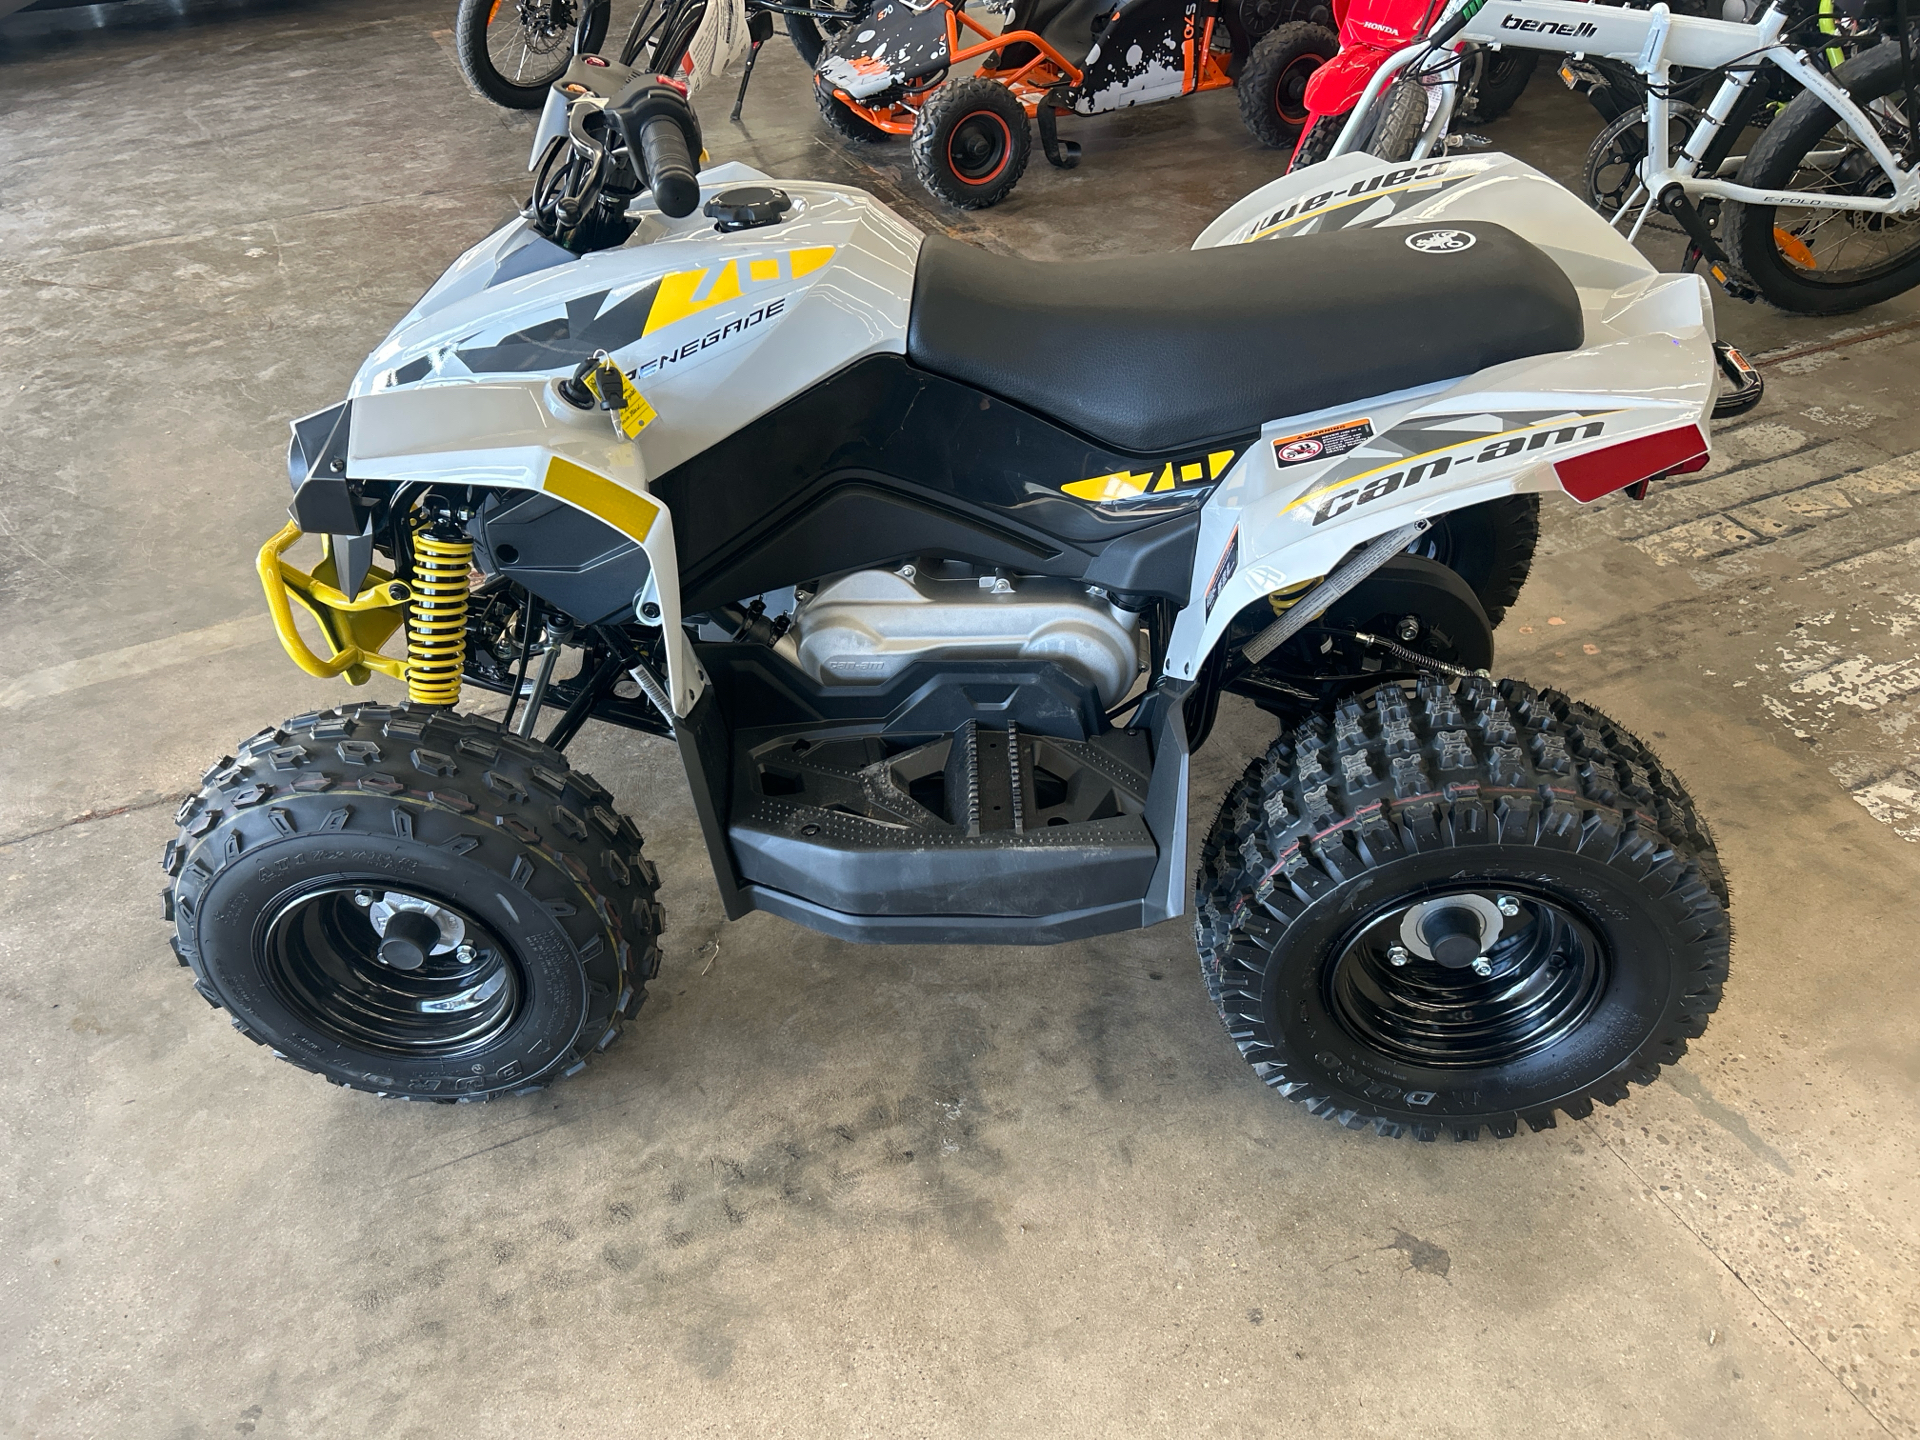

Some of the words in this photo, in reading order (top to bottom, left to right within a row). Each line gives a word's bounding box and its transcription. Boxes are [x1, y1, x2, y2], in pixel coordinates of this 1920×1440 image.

[877, 4, 894, 21] S70
[1363, 21, 1399, 36] HONDA
[1500, 13, 1598, 38] benelli
[1763, 196, 1821, 206] E-FOLD
[1305, 424, 1346, 438] WARNING
[1312, 420, 1605, 526] can-am
[828, 659, 885, 671] can-am
